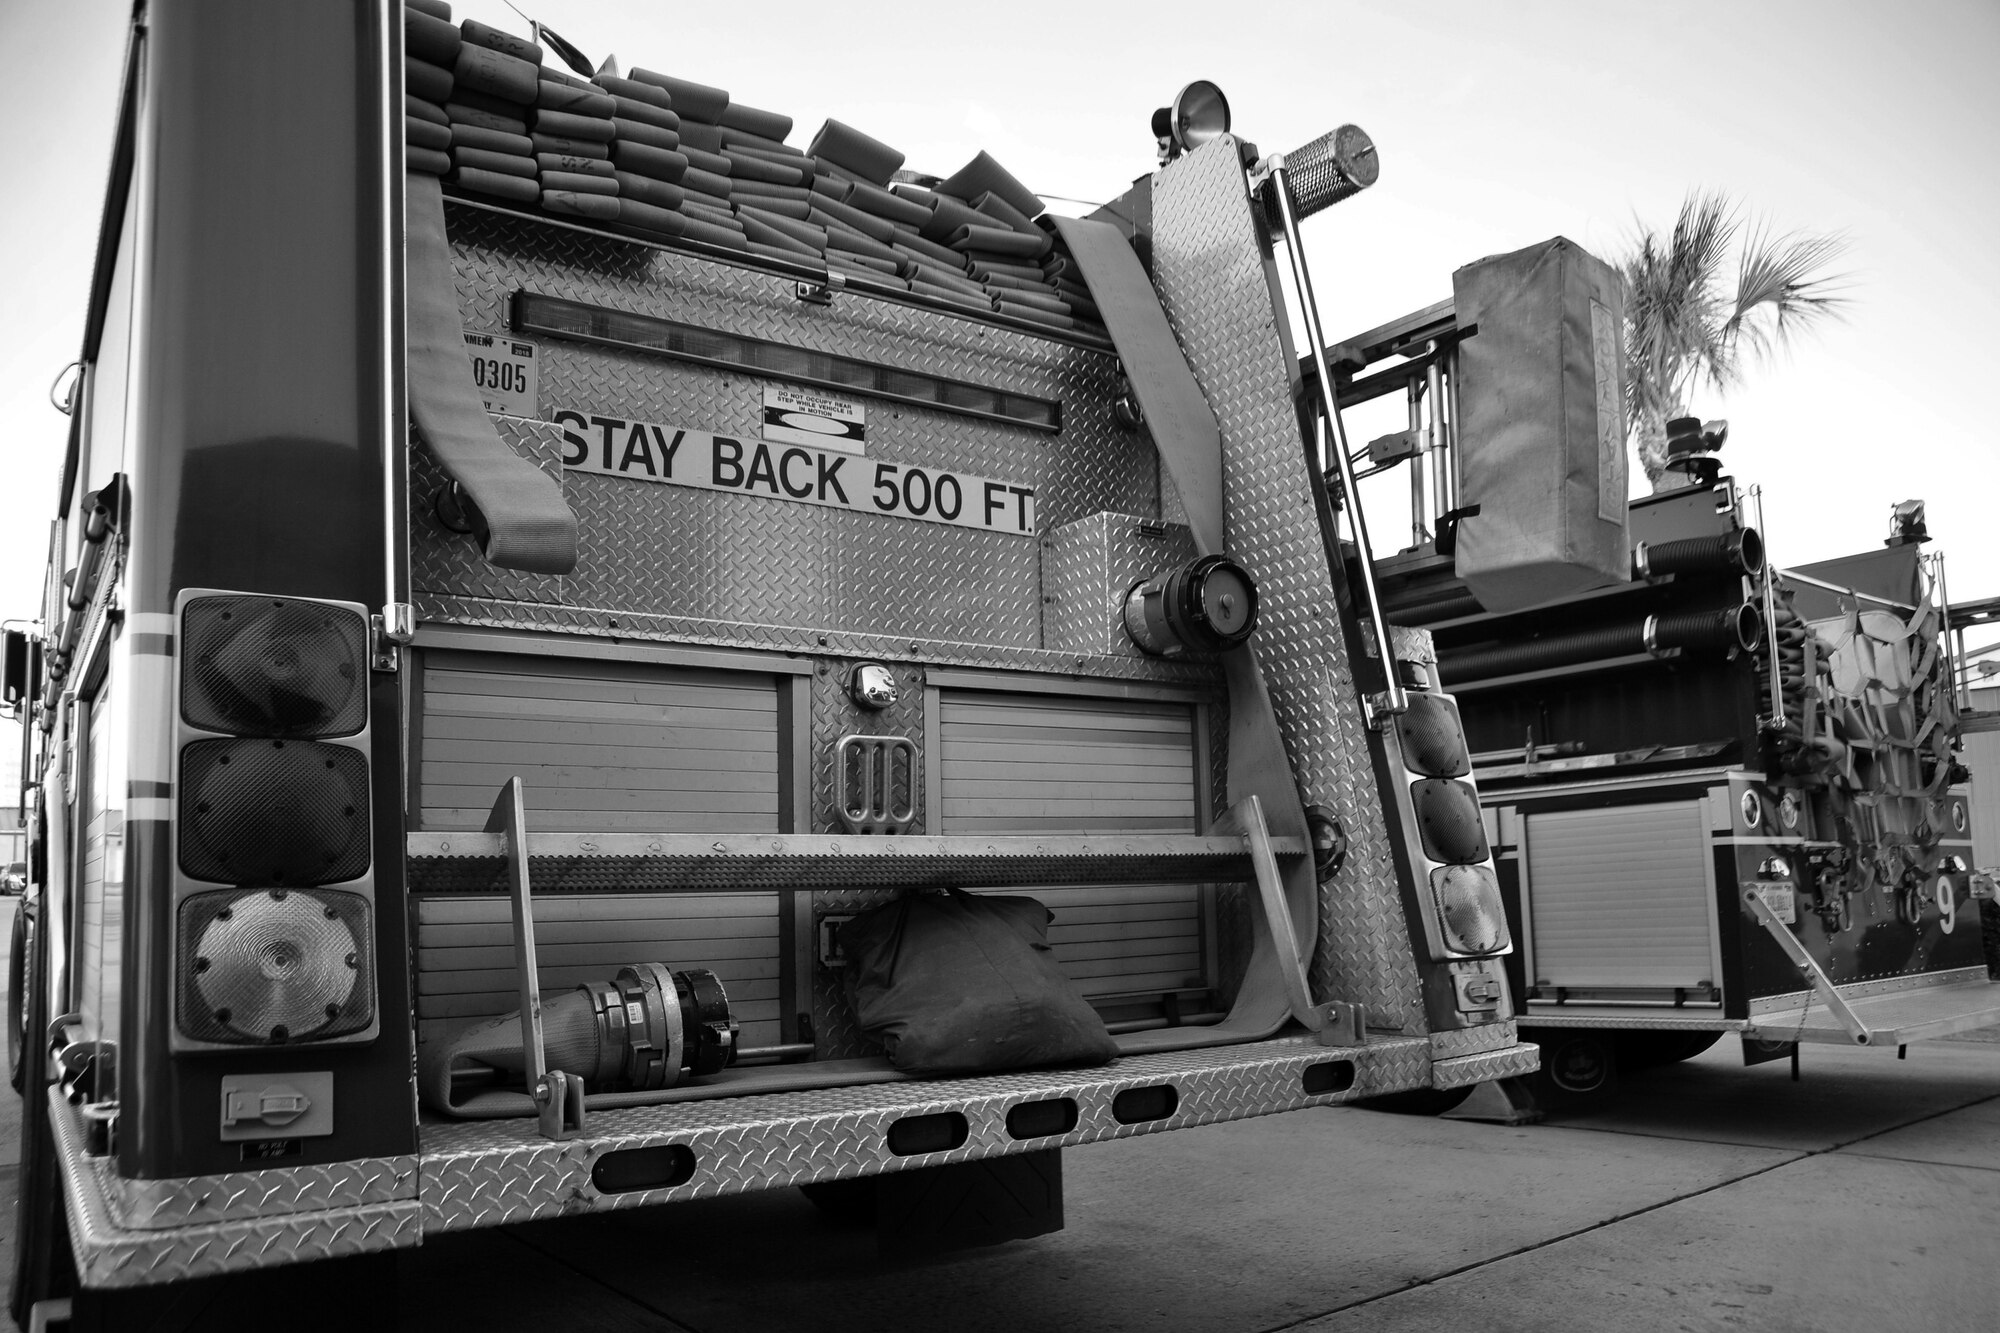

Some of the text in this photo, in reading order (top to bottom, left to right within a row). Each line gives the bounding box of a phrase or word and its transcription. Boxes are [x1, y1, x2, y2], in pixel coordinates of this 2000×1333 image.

[474, 357, 526, 393] 0305
[796, 400, 816, 408] WHILE
[818, 404, 844, 413] VEHICLE
[806, 396, 832, 405] OCCUPY
[835, 401, 852, 409] REAR
[808, 408, 832, 417] MOTION
[553, 410, 686, 478] STAY
[712, 436, 849, 504] BACK
[872, 463, 962, 520] 500
[1936, 876, 1955, 935] 9
